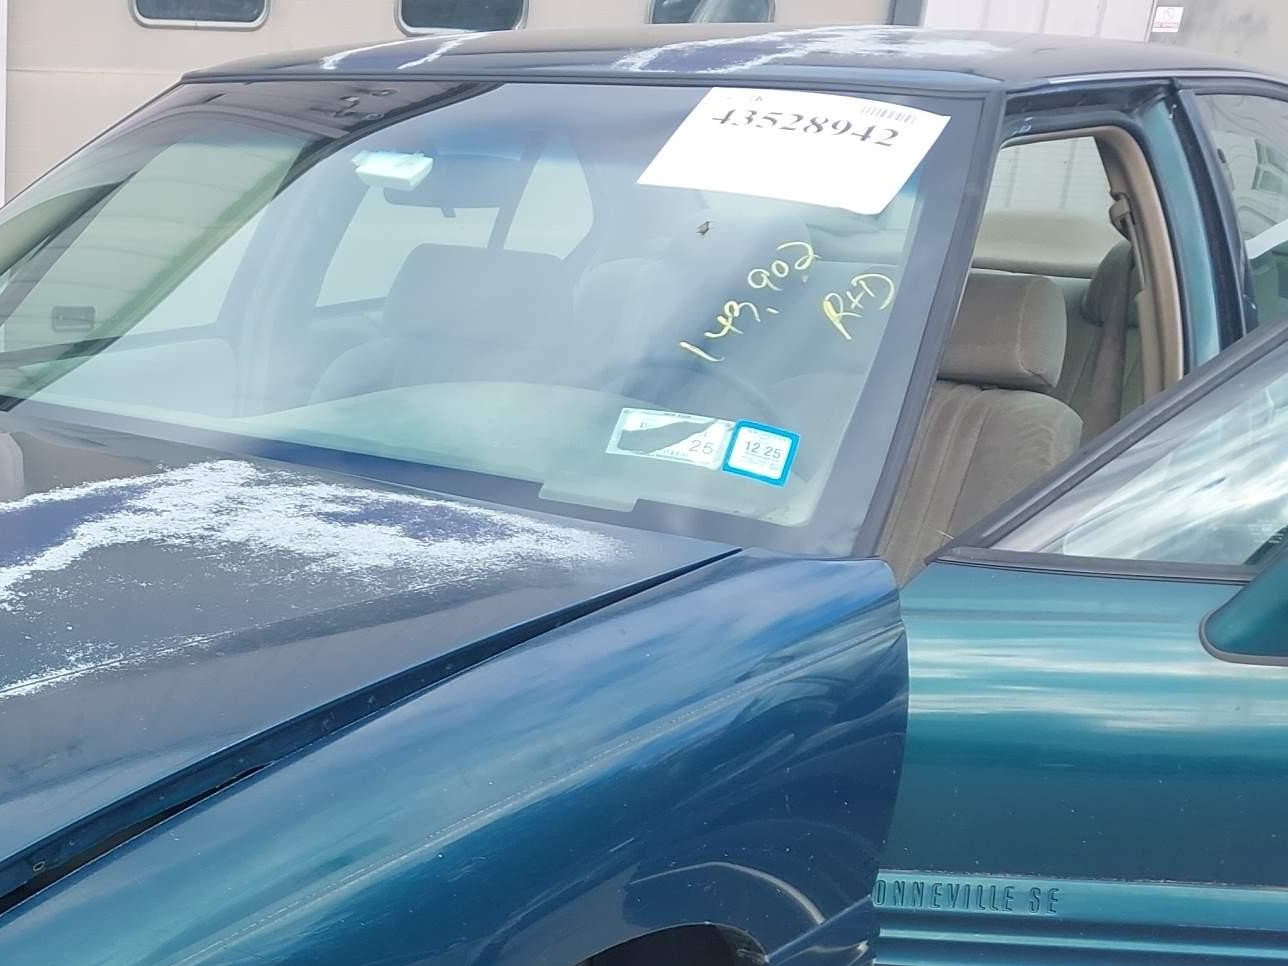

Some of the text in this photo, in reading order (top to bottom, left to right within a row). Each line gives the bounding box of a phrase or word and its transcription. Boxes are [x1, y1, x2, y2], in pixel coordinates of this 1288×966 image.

[712, 108, 900, 148] 43528942
[687, 439, 714, 455] 25
[1028, 886, 1061, 915] SE
